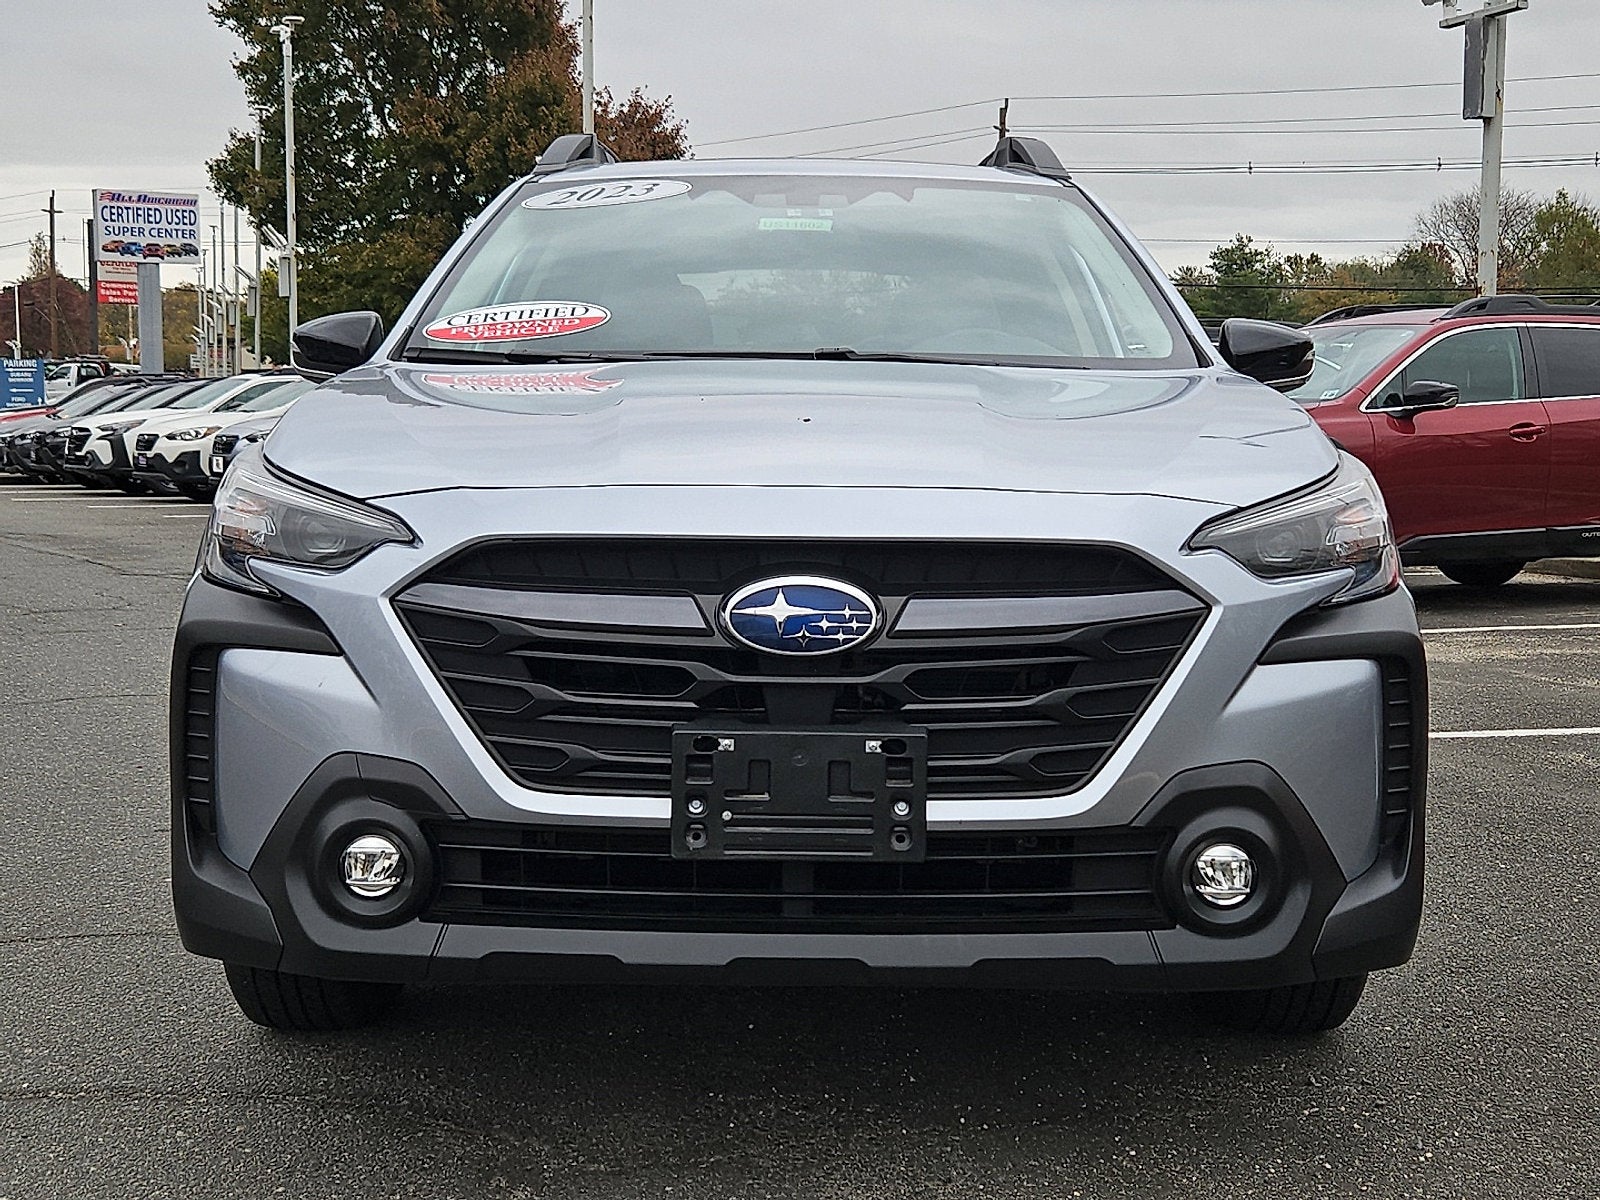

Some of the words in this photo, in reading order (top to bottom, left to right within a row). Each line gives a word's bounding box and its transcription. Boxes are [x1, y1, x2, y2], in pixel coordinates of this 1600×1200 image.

[547, 183, 661, 206] 2023
[101, 205, 163, 225] CERTIFIED
[165, 208, 197, 226] USED
[104, 225, 146, 237] SUPER
[148, 227, 197, 240] CENTER
[447, 306, 590, 327] CERTIFIED
[450, 318, 581, 335] PRE-OWNED
[468, 326, 560, 339] VEHICLE
[3, 359, 38, 368] PARKING
